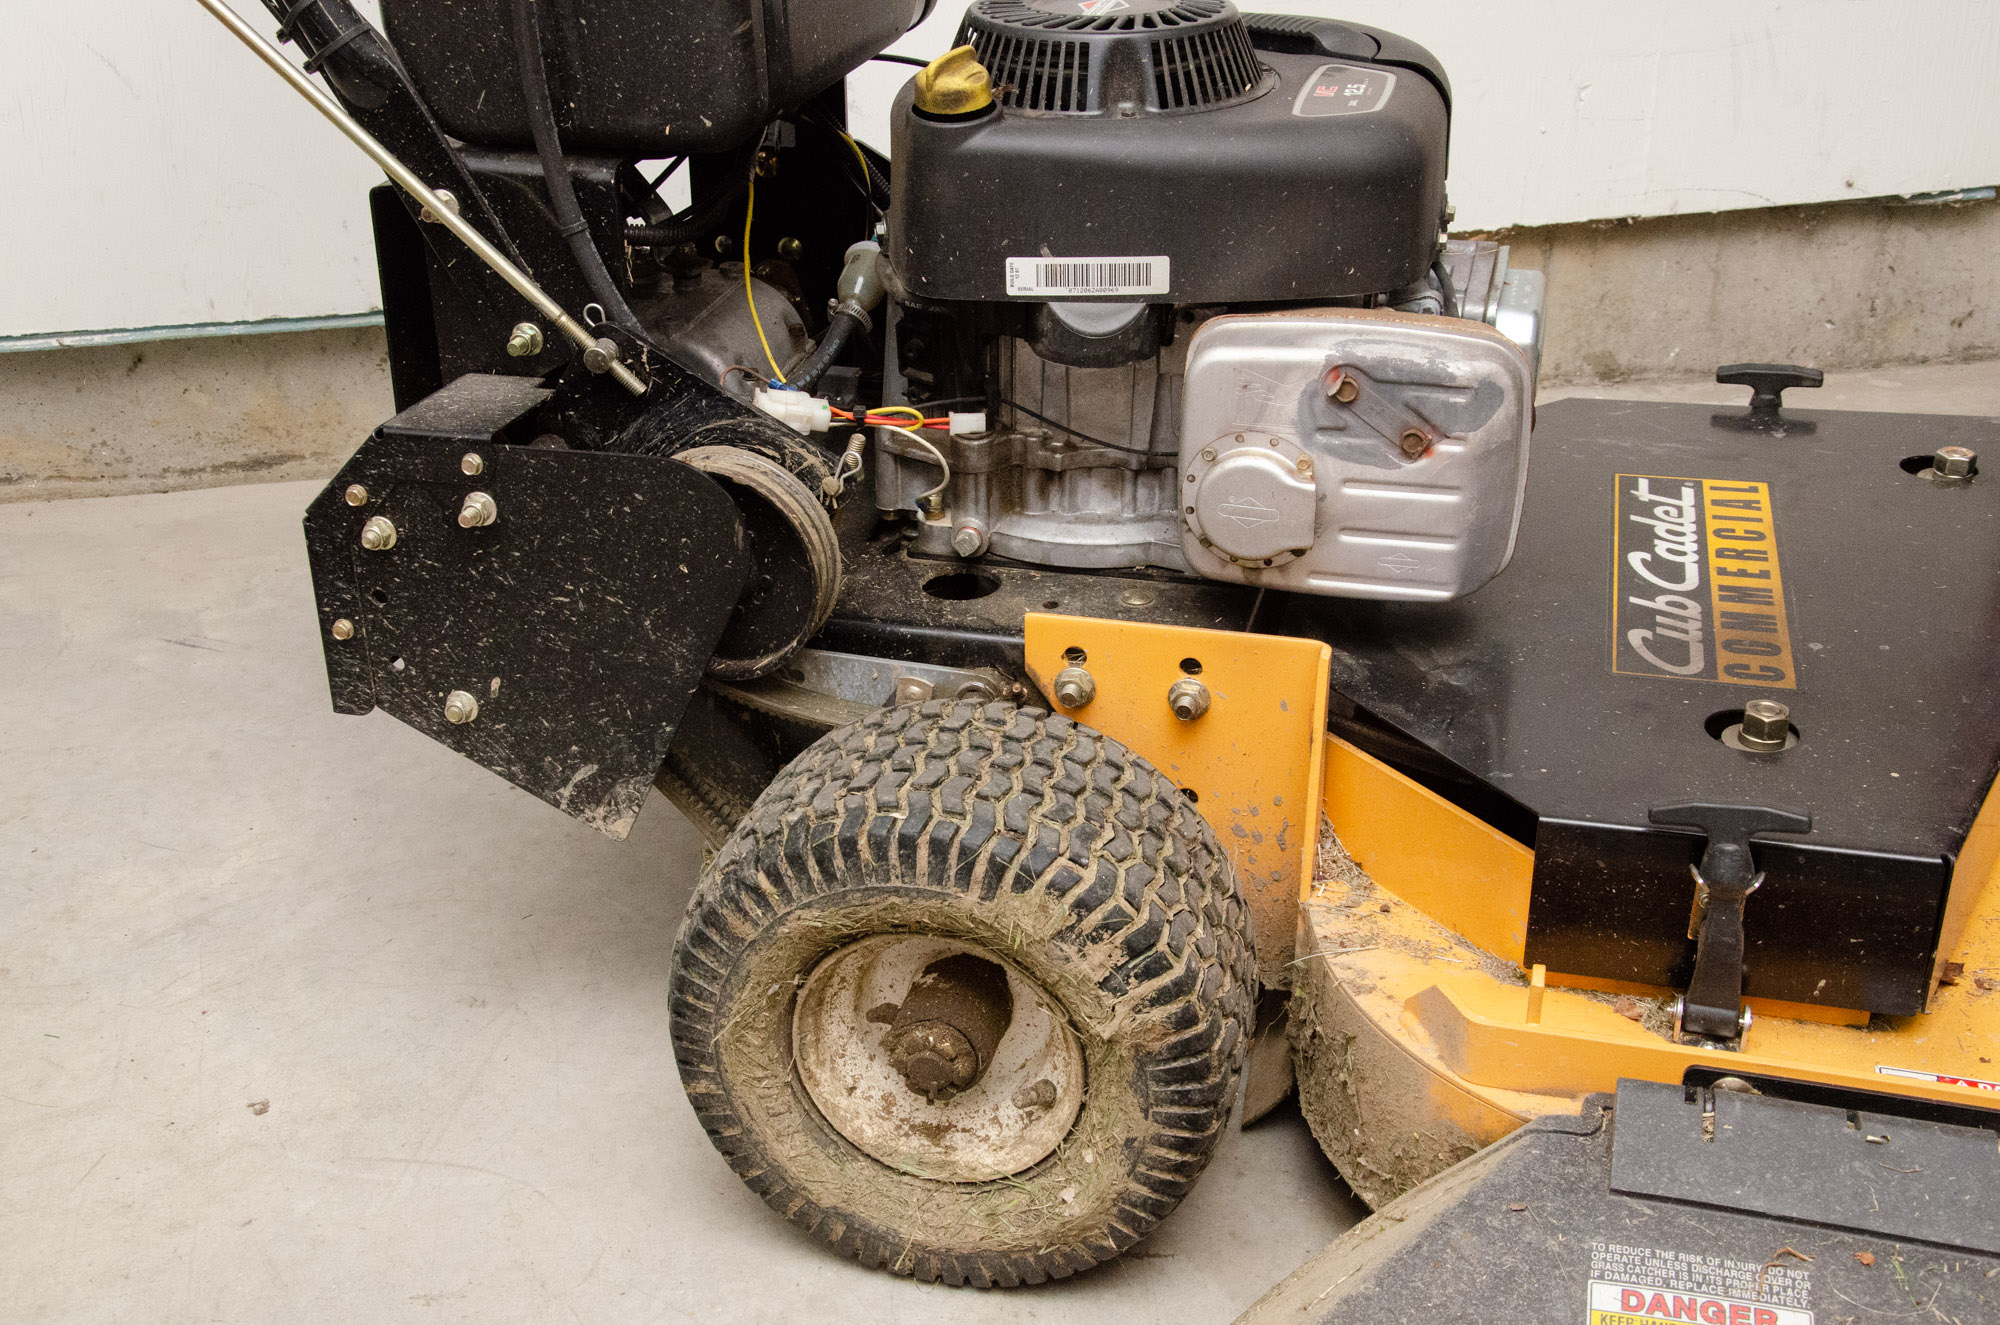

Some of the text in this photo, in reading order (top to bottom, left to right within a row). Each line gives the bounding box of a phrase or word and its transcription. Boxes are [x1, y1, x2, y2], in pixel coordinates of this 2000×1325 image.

[1627, 477, 1705, 675] Cub Cadet
[1709, 485, 1786, 682] COMMERCIAL
[1590, 1260, 1625, 1272] GRASS
[1627, 1264, 1676, 1278] CATCHER
[1679, 1271, 1689, 1281] IS
[1691, 1273, 1703, 1283] IN
[1706, 1275, 1722, 1286] ITS
[1725, 1278, 1769, 1293] PROPER
[1591, 1242, 1605, 1252] TO
[1608, 1244, 1652, 1257] REDUCE
[1654, 1249, 1676, 1260] THE
[1678, 1252, 1703, 1264] RISK
[1706, 1256, 1721, 1266] OF
[1768, 1266, 1784, 1276] DO
[1787, 1269, 1810, 1280] NOT
[1591, 1251, 1811, 1290] OPERATE UNLESS DISCHARGE COVER OR
[1590, 1269, 1601, 1278] IF
[1670, 1279, 1724, 1296] REPLACE
[1621, 1288, 1778, 1325] DANGER
